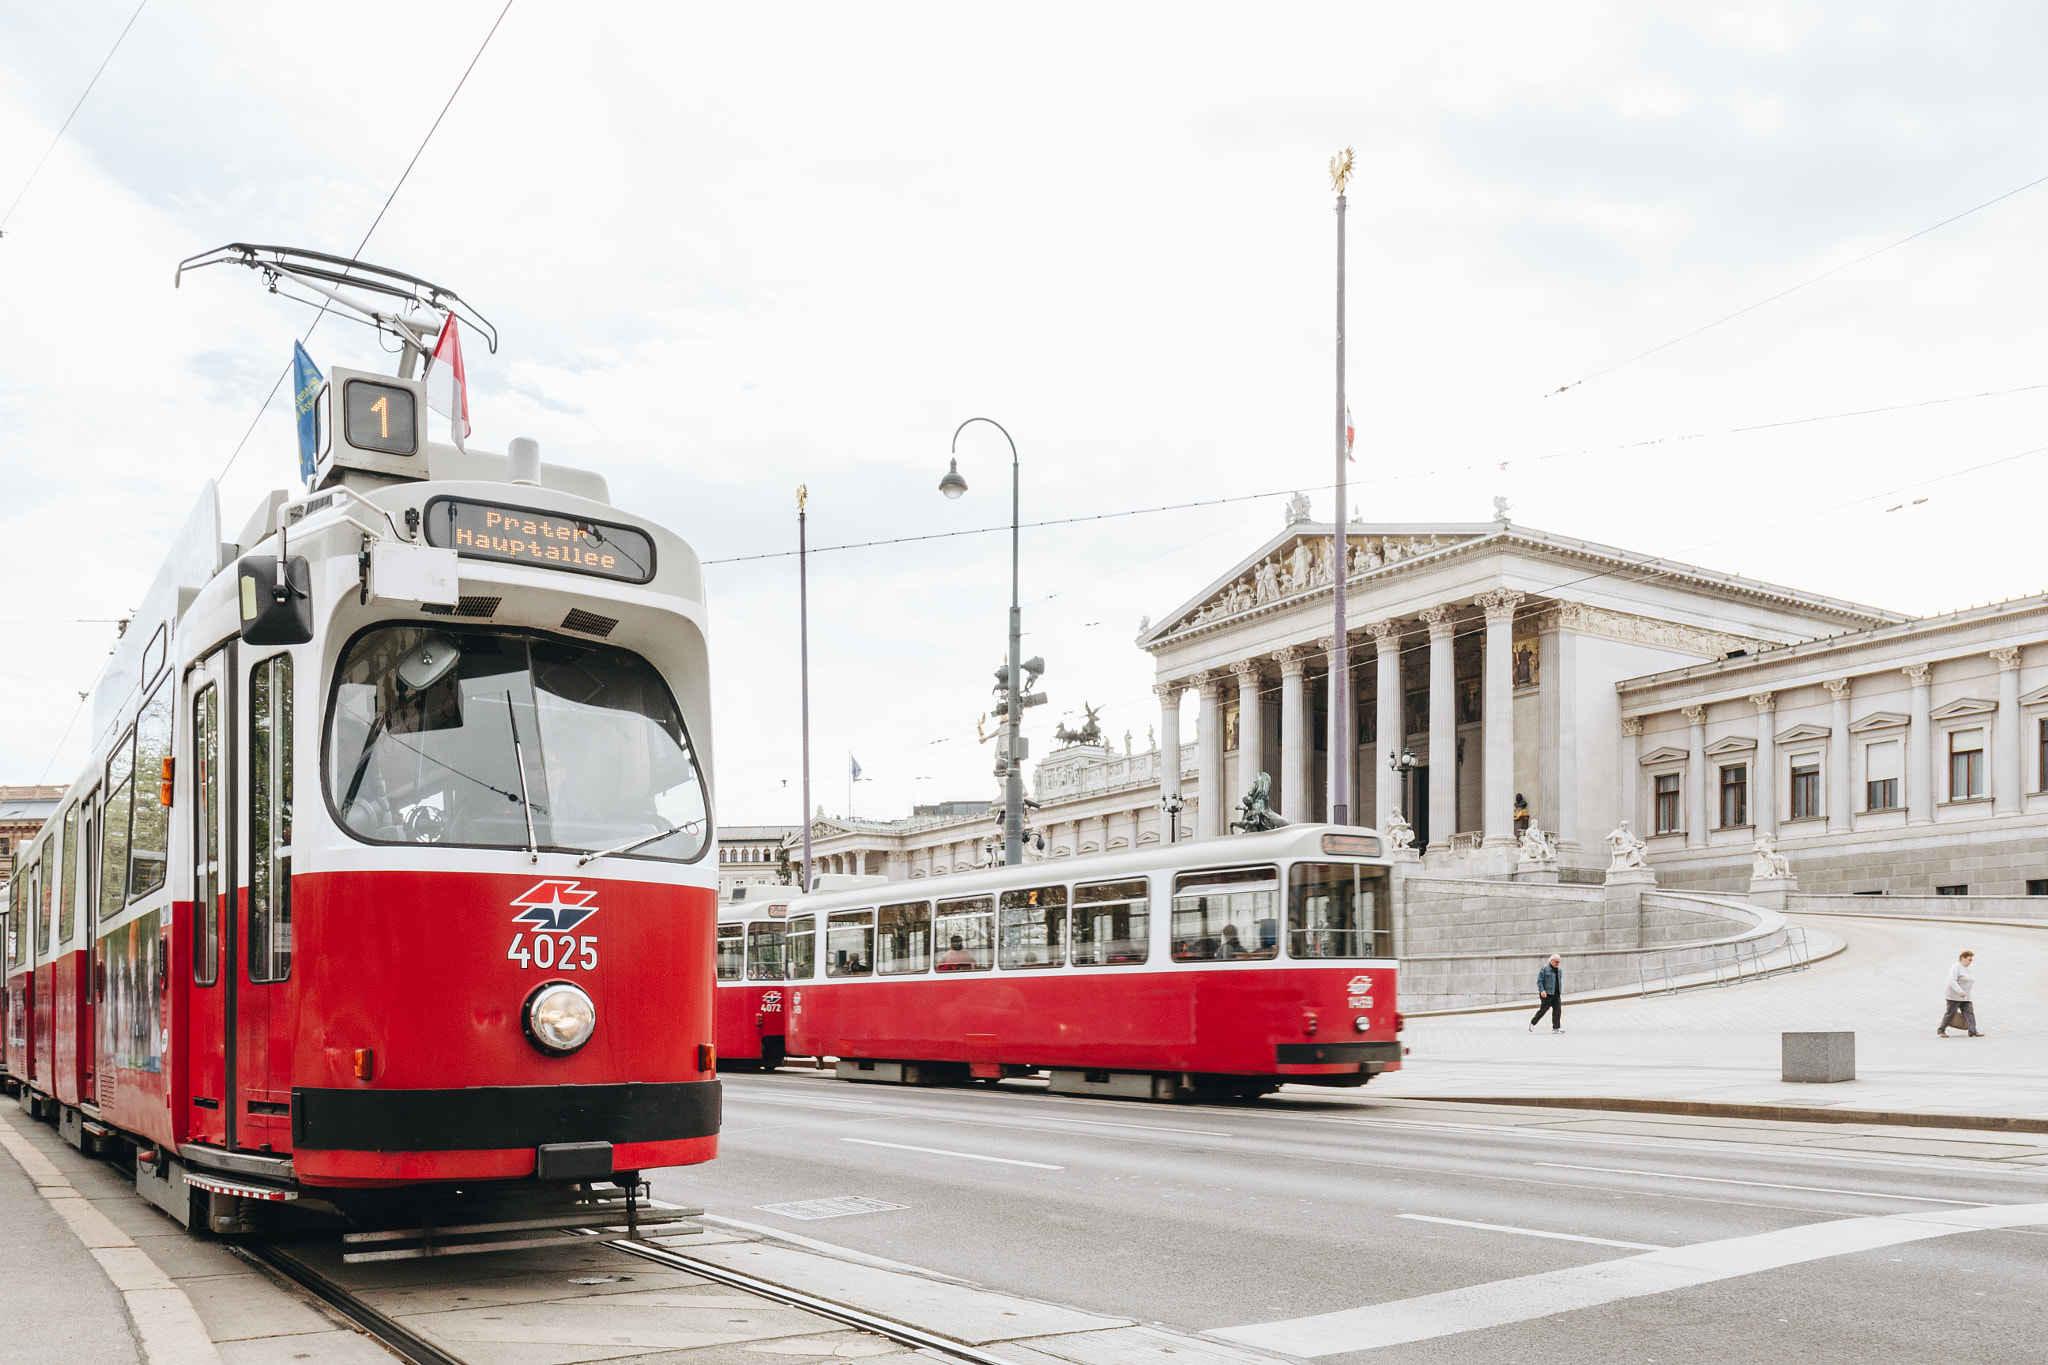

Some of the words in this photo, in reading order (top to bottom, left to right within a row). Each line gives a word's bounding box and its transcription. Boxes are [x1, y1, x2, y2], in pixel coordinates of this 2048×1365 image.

[370, 396, 389, 439] 1
[456, 528, 616, 570] Hauptallee
[1028, 891, 1038, 905] 2
[507, 932, 599, 971] 4025
[760, 1003, 782, 1013] 4072
